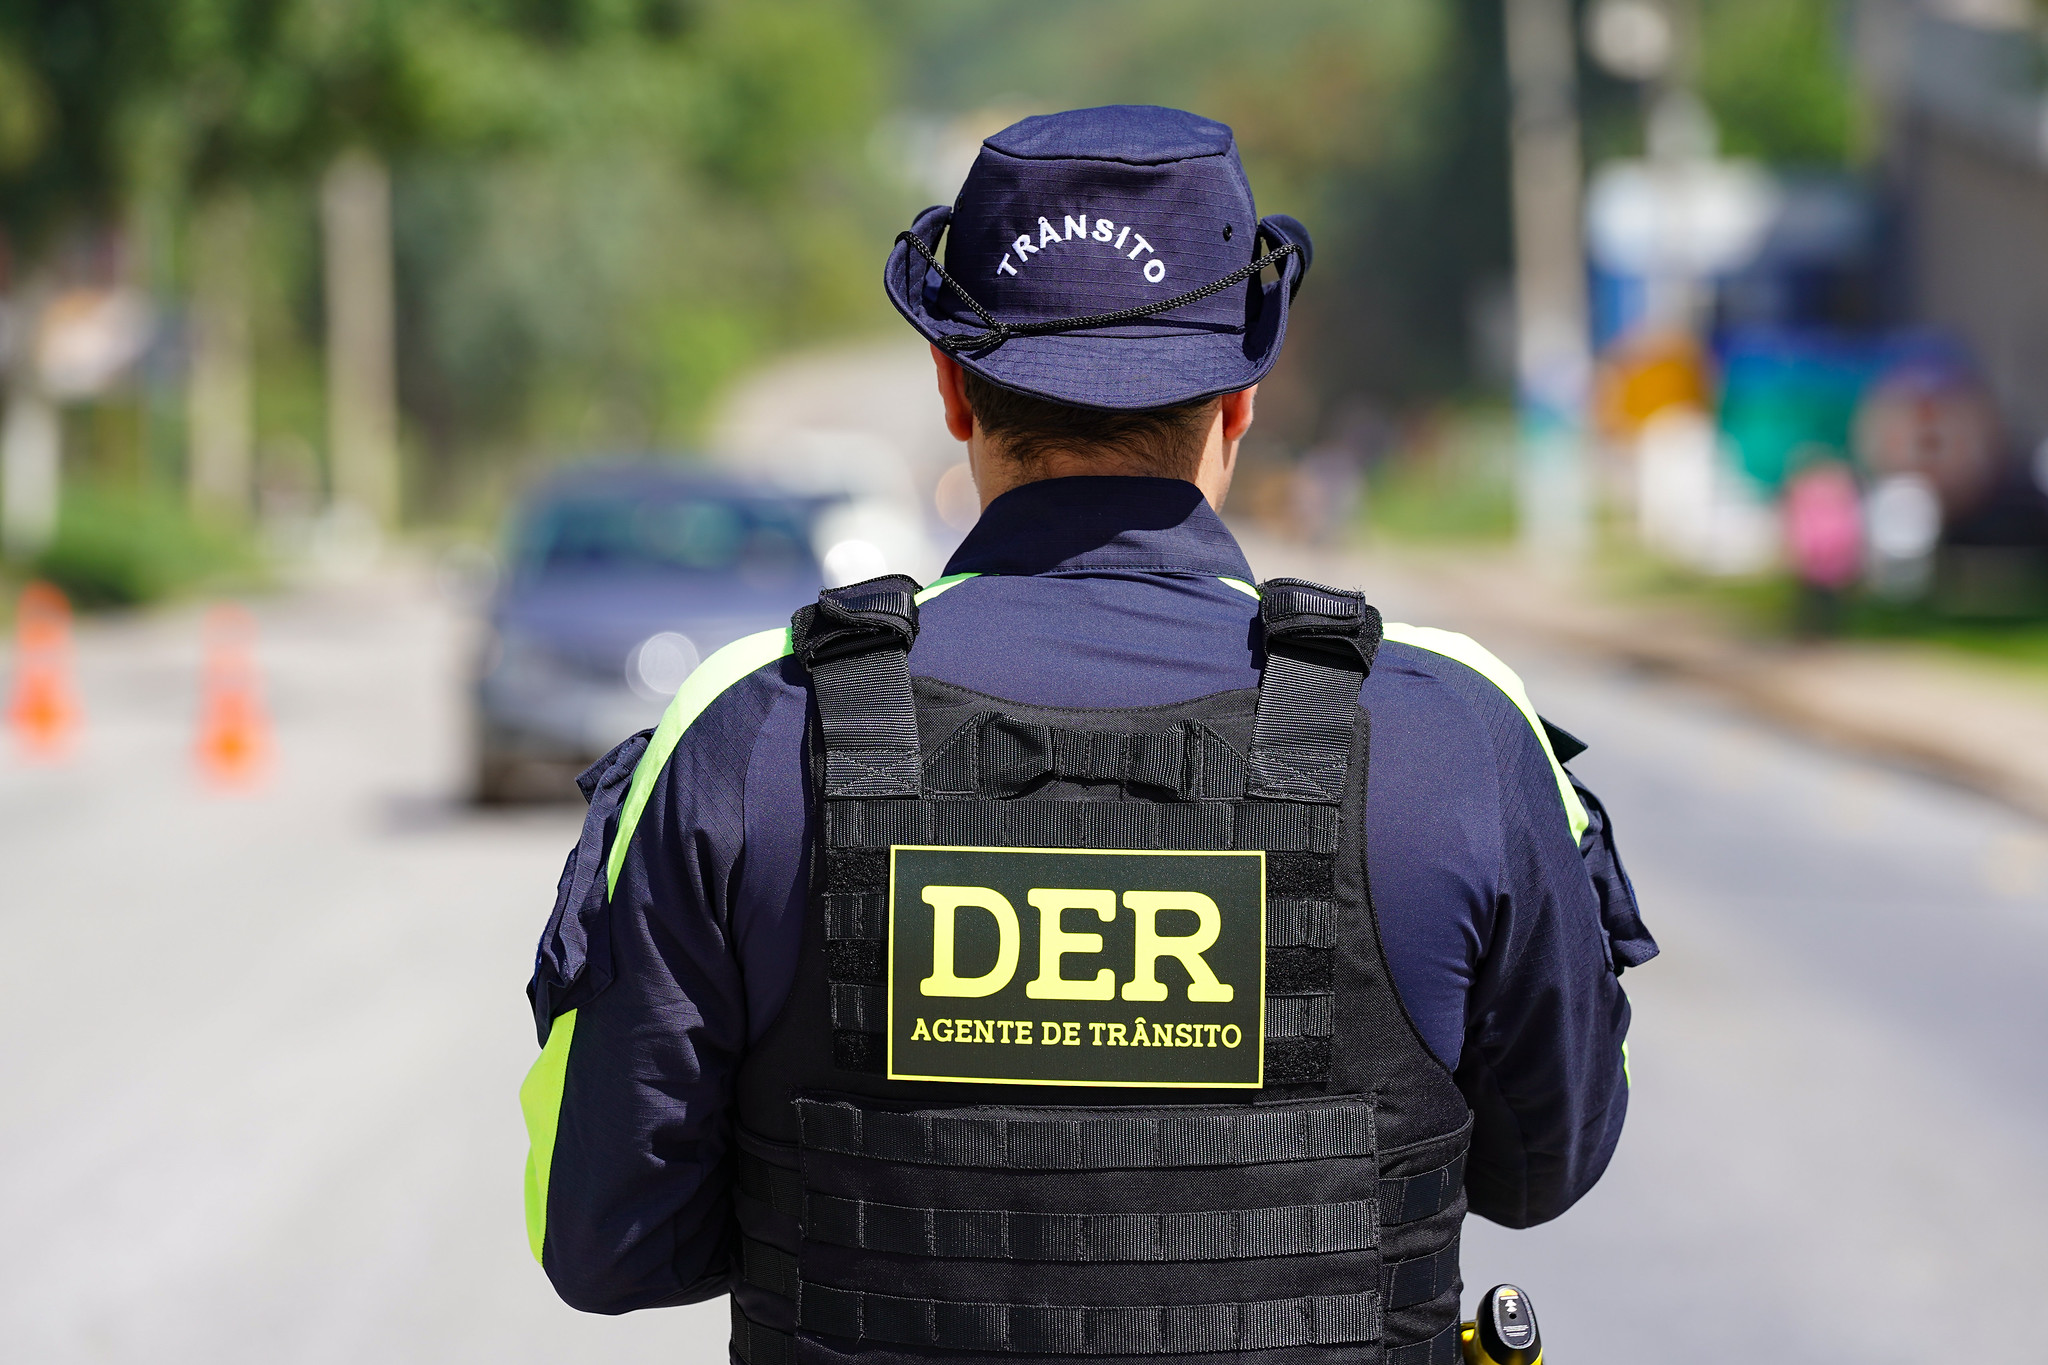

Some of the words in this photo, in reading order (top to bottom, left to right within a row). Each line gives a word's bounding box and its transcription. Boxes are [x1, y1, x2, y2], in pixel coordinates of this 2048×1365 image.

[996, 214, 1166, 284] TRÂNSITO
[919, 885, 1234, 1003] DER
[910, 1017, 1033, 1045] AGENTE
[1040, 1021, 1081, 1046] DE
[1088, 1016, 1242, 1049] TRÂNSITO
